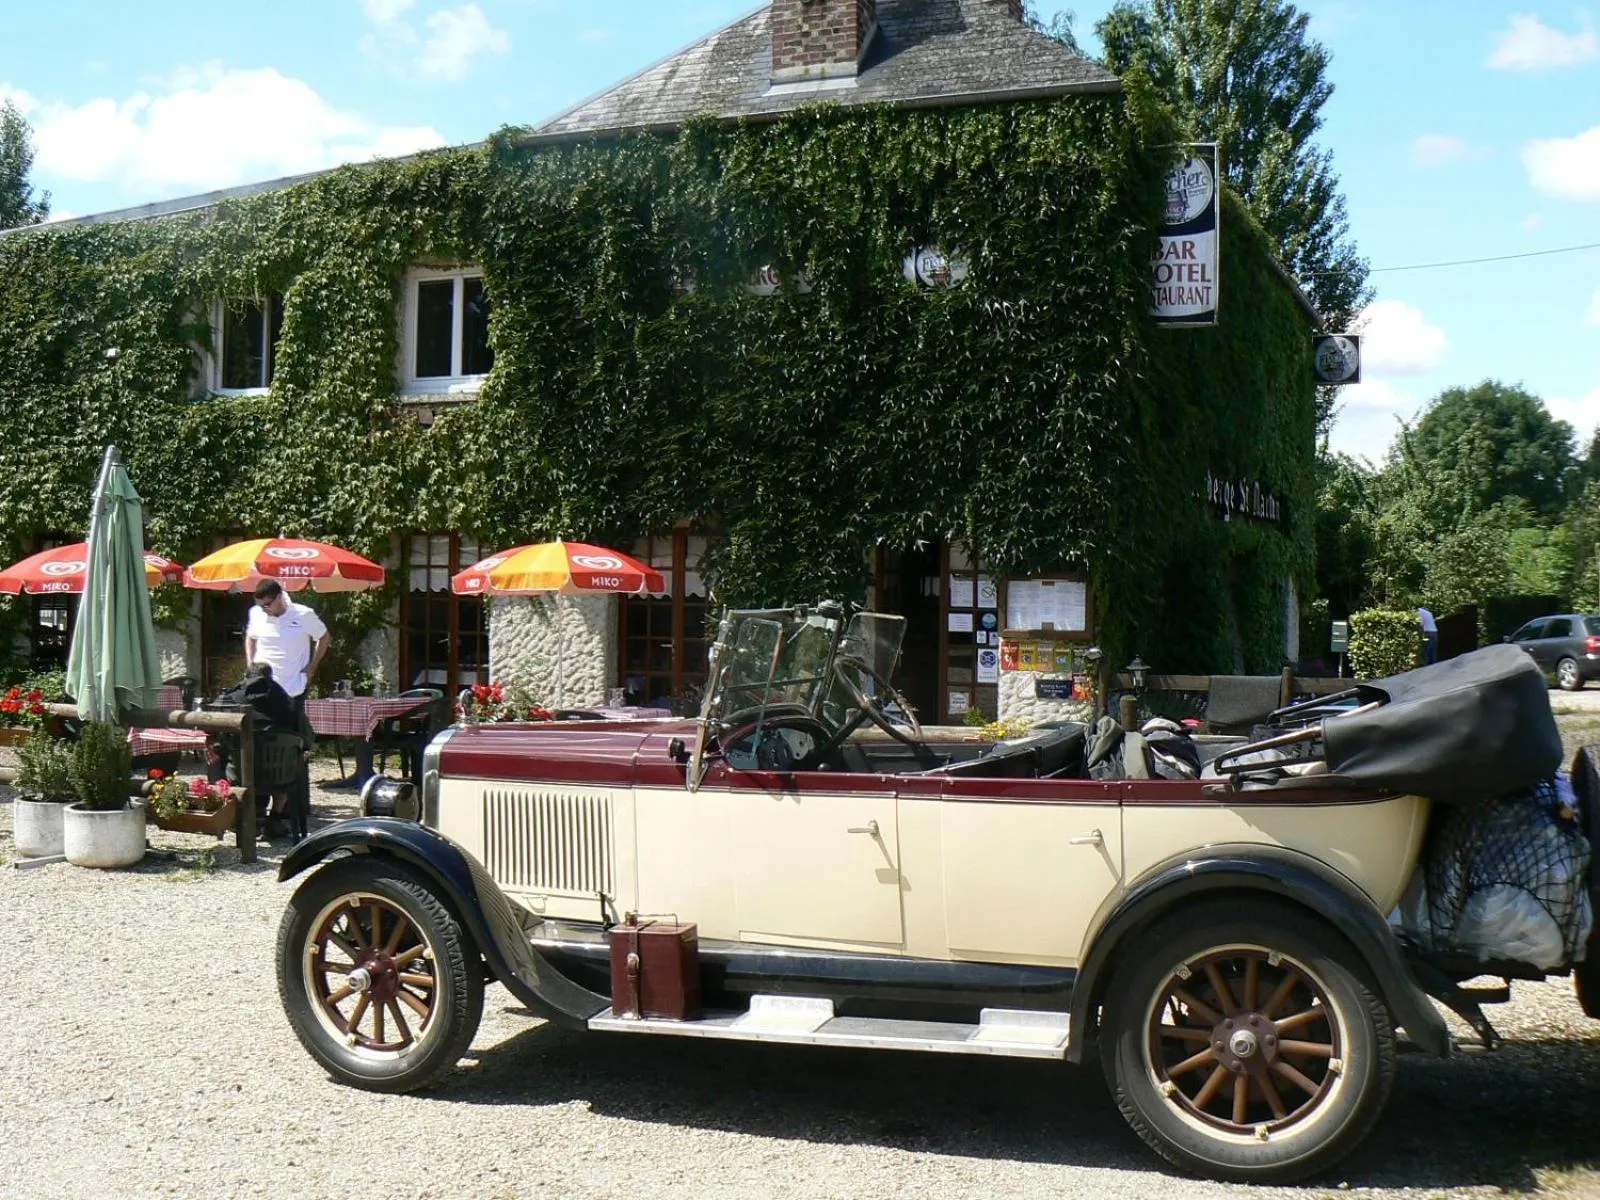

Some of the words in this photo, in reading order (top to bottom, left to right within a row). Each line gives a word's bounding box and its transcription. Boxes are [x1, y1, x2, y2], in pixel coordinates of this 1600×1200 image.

[1155, 240, 1197, 260] BAR
[1151, 263, 1212, 284] OTEL
[1151, 285, 1212, 306] STAURANT
[279, 565, 310, 576] MIKO
[42, 582, 70, 591] MIKO
[591, 576, 620, 588] MIKO
